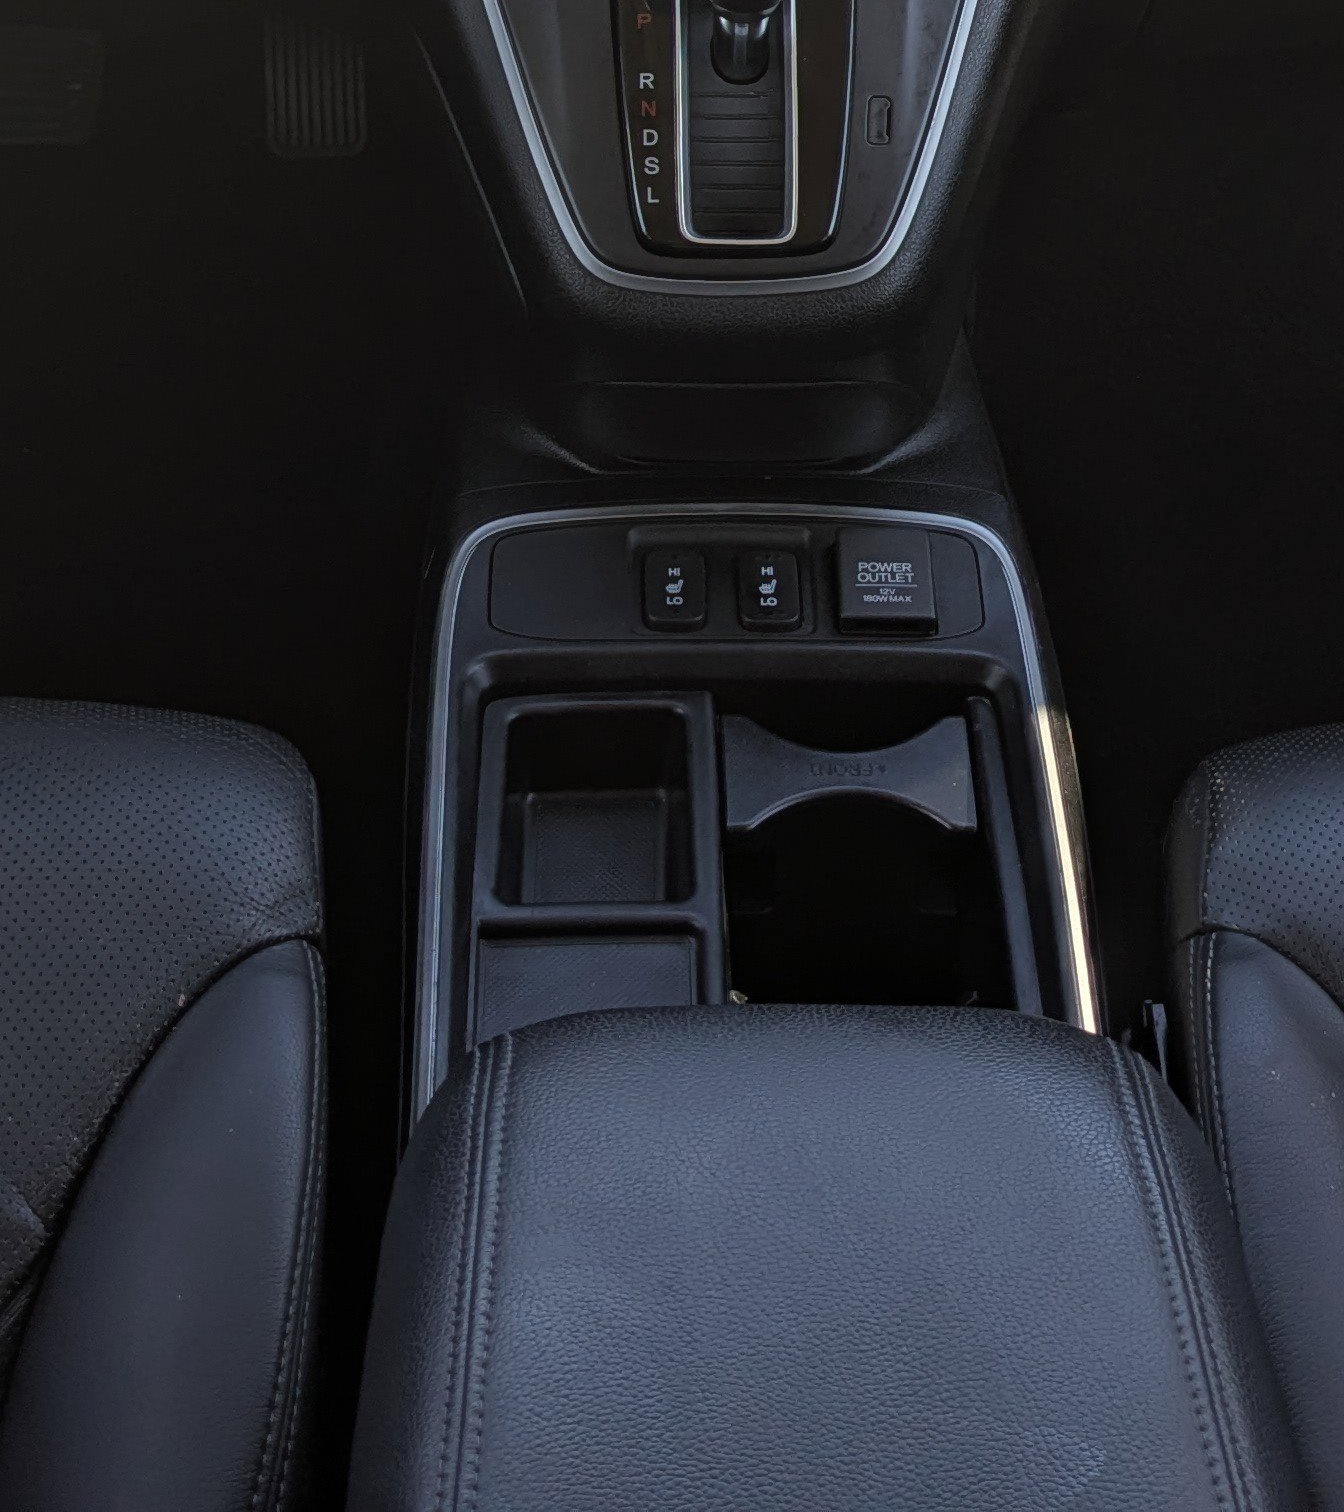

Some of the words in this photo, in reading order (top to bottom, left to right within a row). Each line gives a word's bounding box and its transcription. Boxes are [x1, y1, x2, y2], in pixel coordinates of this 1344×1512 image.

[636, 13, 652, 30] P
[639, 72, 655, 89] R
[641, 100, 656, 117] N
[643, 129, 659, 146] D
[643, 157, 660, 175] S
[646, 186, 660, 204] L
[668, 567, 681, 577] HI
[760, 566, 774, 576] HI
[858, 561, 913, 573] POWER
[857, 572, 915, 583] OUTLET
[666, 596, 684, 606] LO
[760, 597, 778, 607] LO
